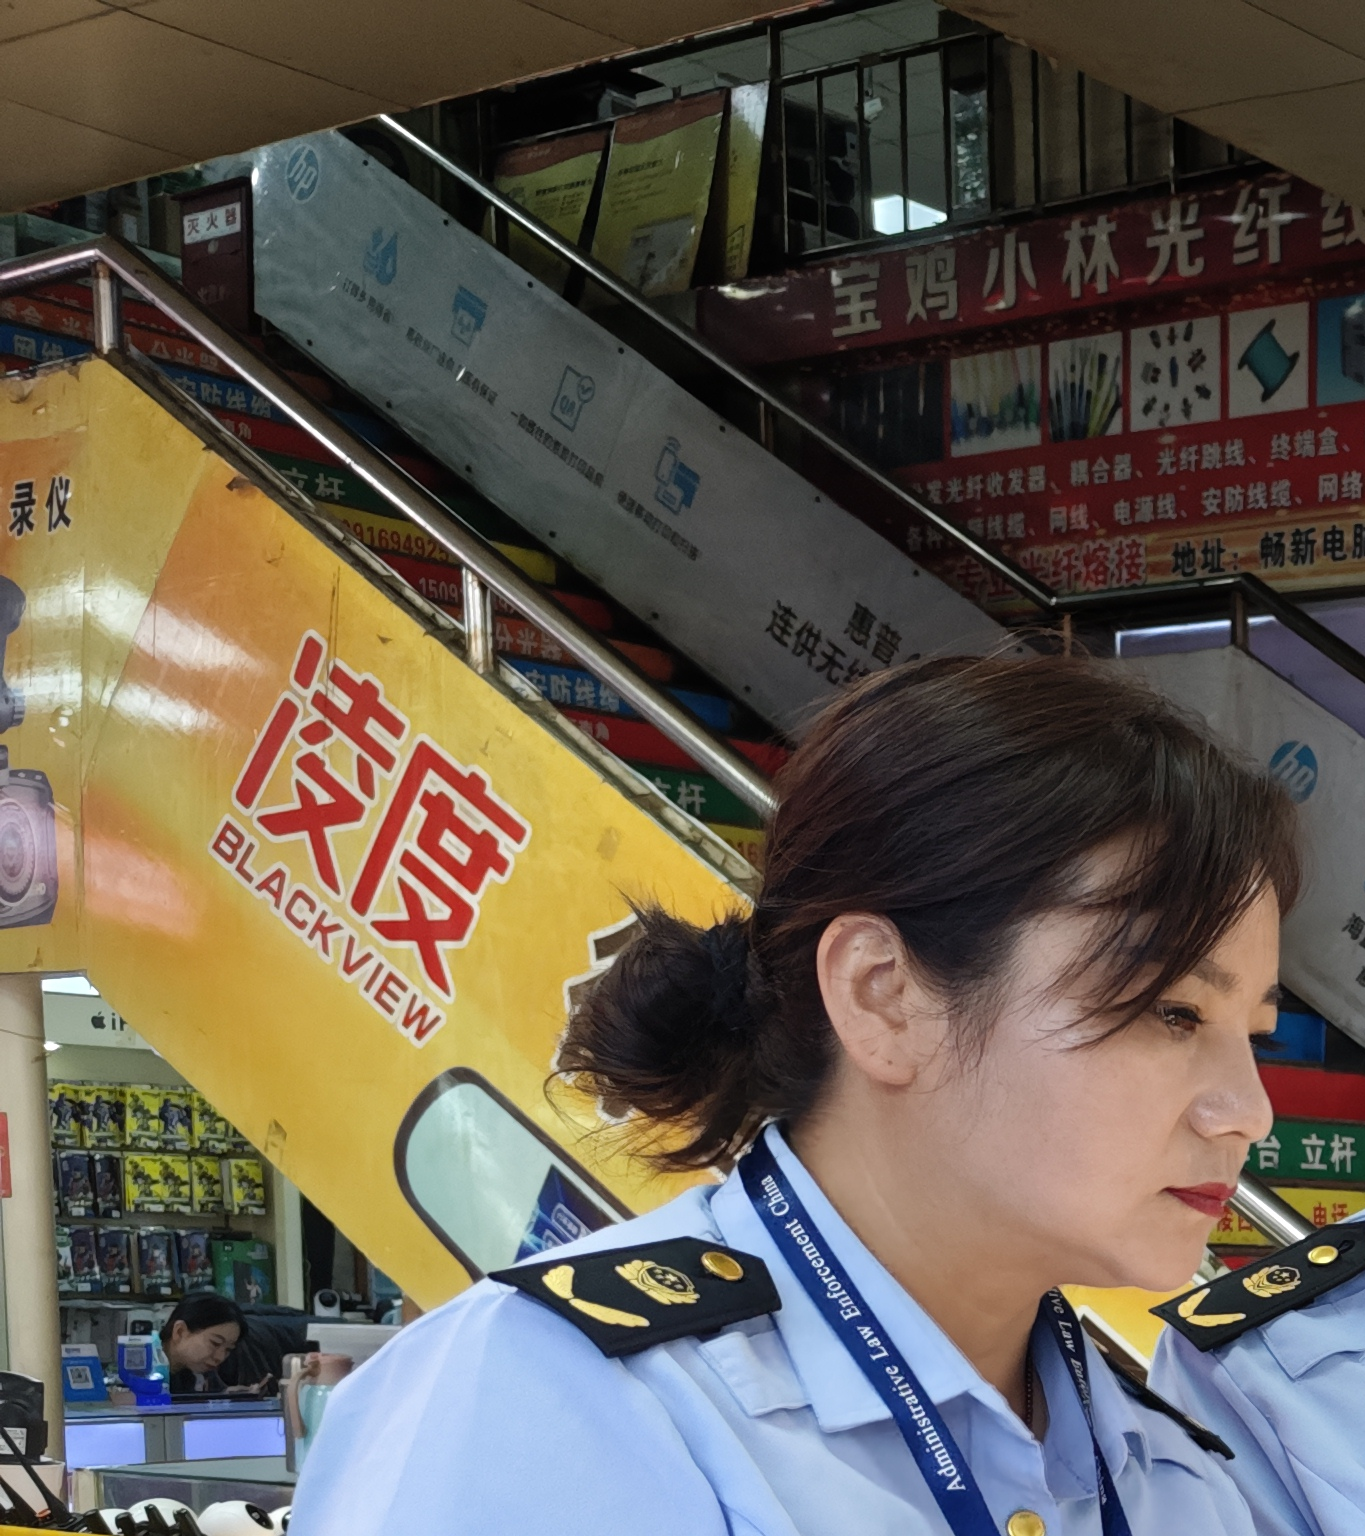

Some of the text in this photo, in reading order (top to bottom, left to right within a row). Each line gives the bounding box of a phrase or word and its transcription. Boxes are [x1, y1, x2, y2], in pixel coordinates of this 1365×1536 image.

[186, 206, 240, 237] 灭火器
[7, 474, 72, 538] 录仪
[233, 634, 530, 1000] 凌度
[211, 822, 444, 1043] BLACKVIEW
[1300, 1132, 1358, 1174] 立杆
[760, 1174, 968, 1494] Administrative Law Enforcement China
